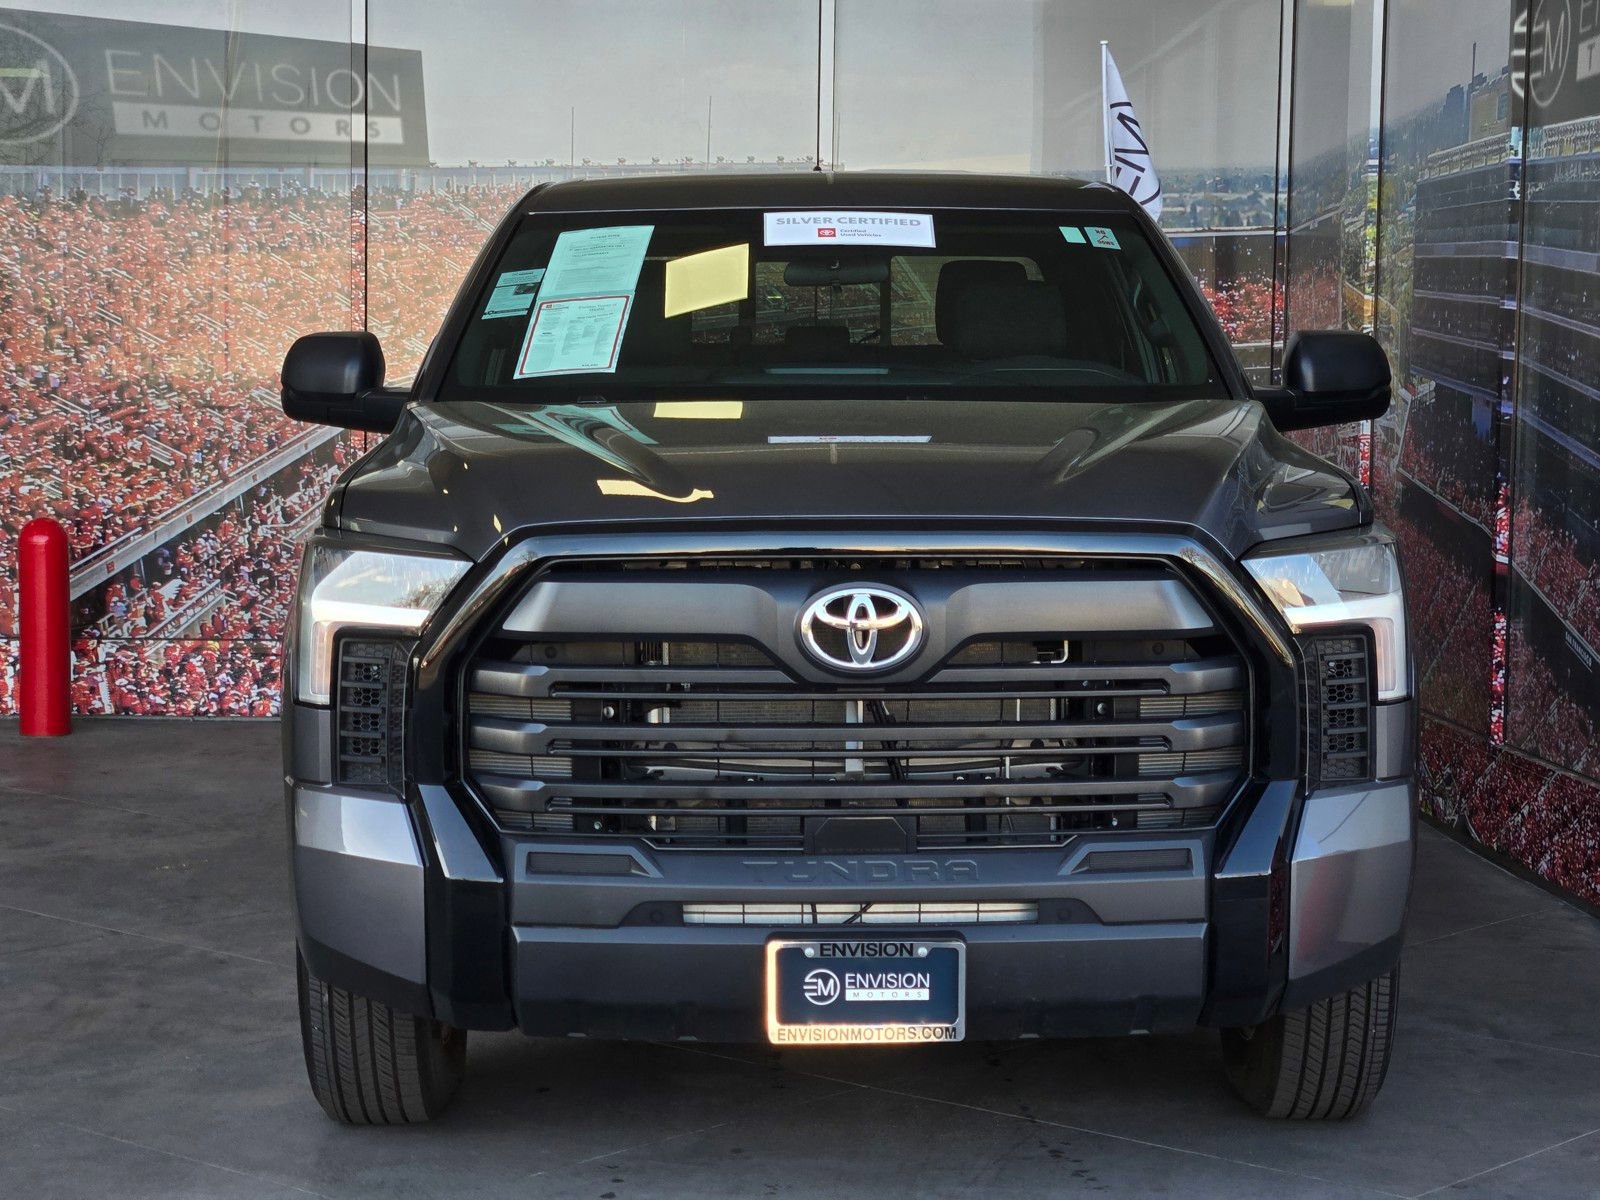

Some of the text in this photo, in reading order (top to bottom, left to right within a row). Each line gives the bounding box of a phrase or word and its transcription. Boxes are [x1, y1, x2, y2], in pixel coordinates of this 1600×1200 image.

[105, 48, 401, 112] ENVISION
[142, 111, 382, 138] MOTORS
[775, 216, 921, 227] SILVER CERTIFIED
[741, 859, 980, 883] TUNDRA
[819, 942, 914, 958] ENVISION
[845, 973, 930, 989] ENVISION
[777, 1026, 957, 1042] ENVISIONMOTORS.COM
